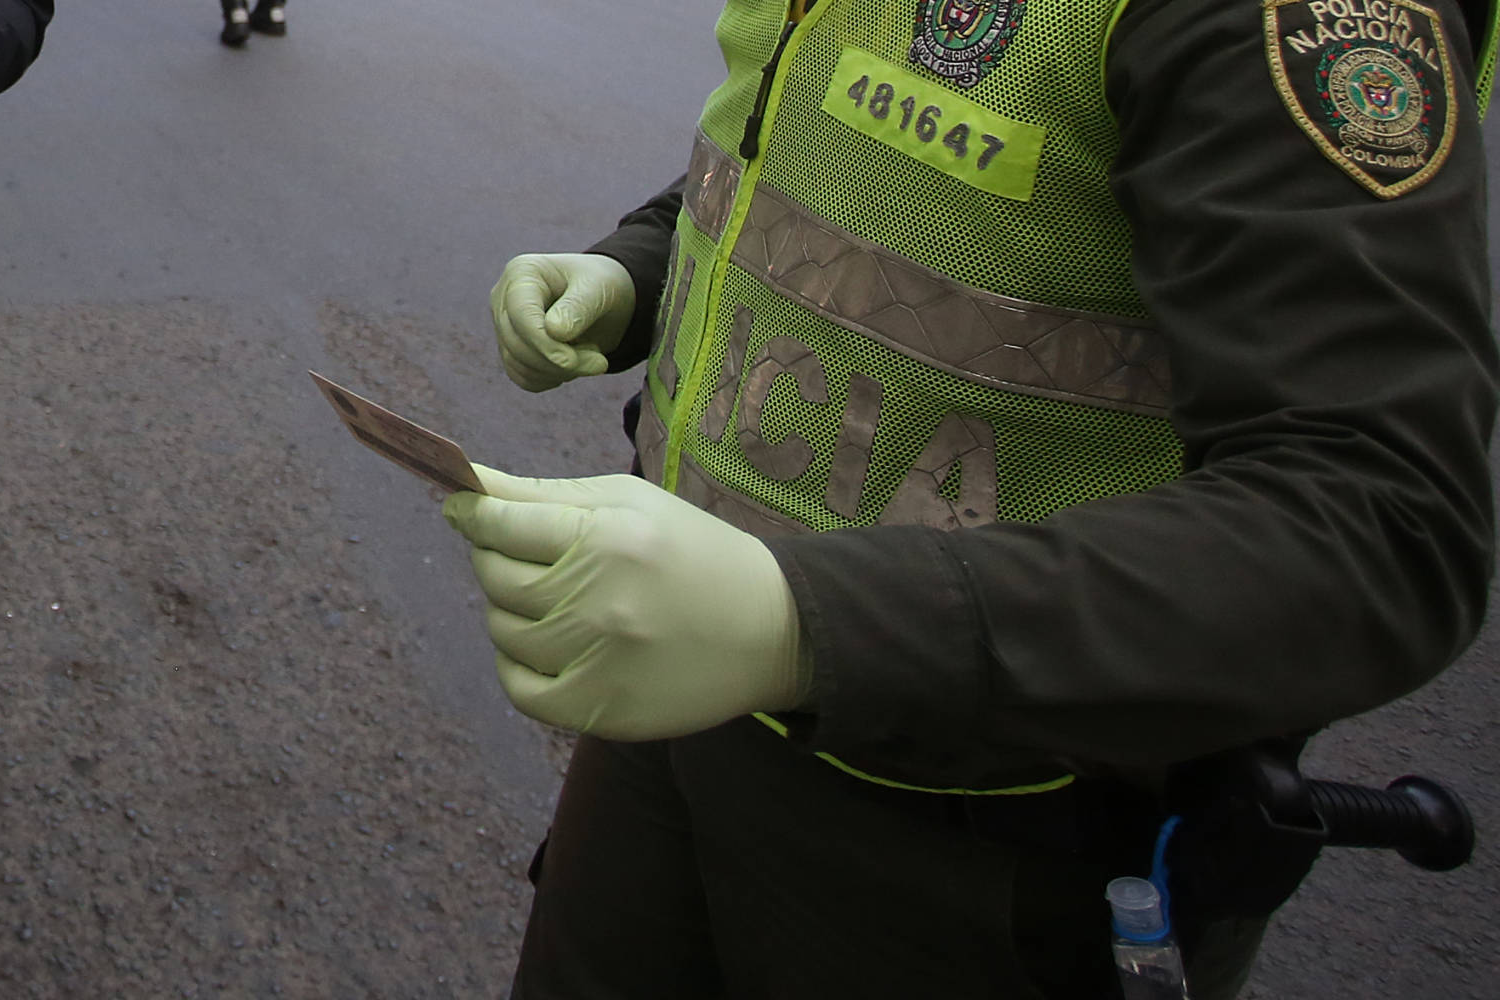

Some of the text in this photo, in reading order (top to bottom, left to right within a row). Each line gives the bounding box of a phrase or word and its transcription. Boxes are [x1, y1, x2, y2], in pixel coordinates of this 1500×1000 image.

[1285, 18, 1439, 71] NACIONAL
[847, 75, 1005, 170] 481647
[1341, 145, 1427, 168] COLOMBIA
